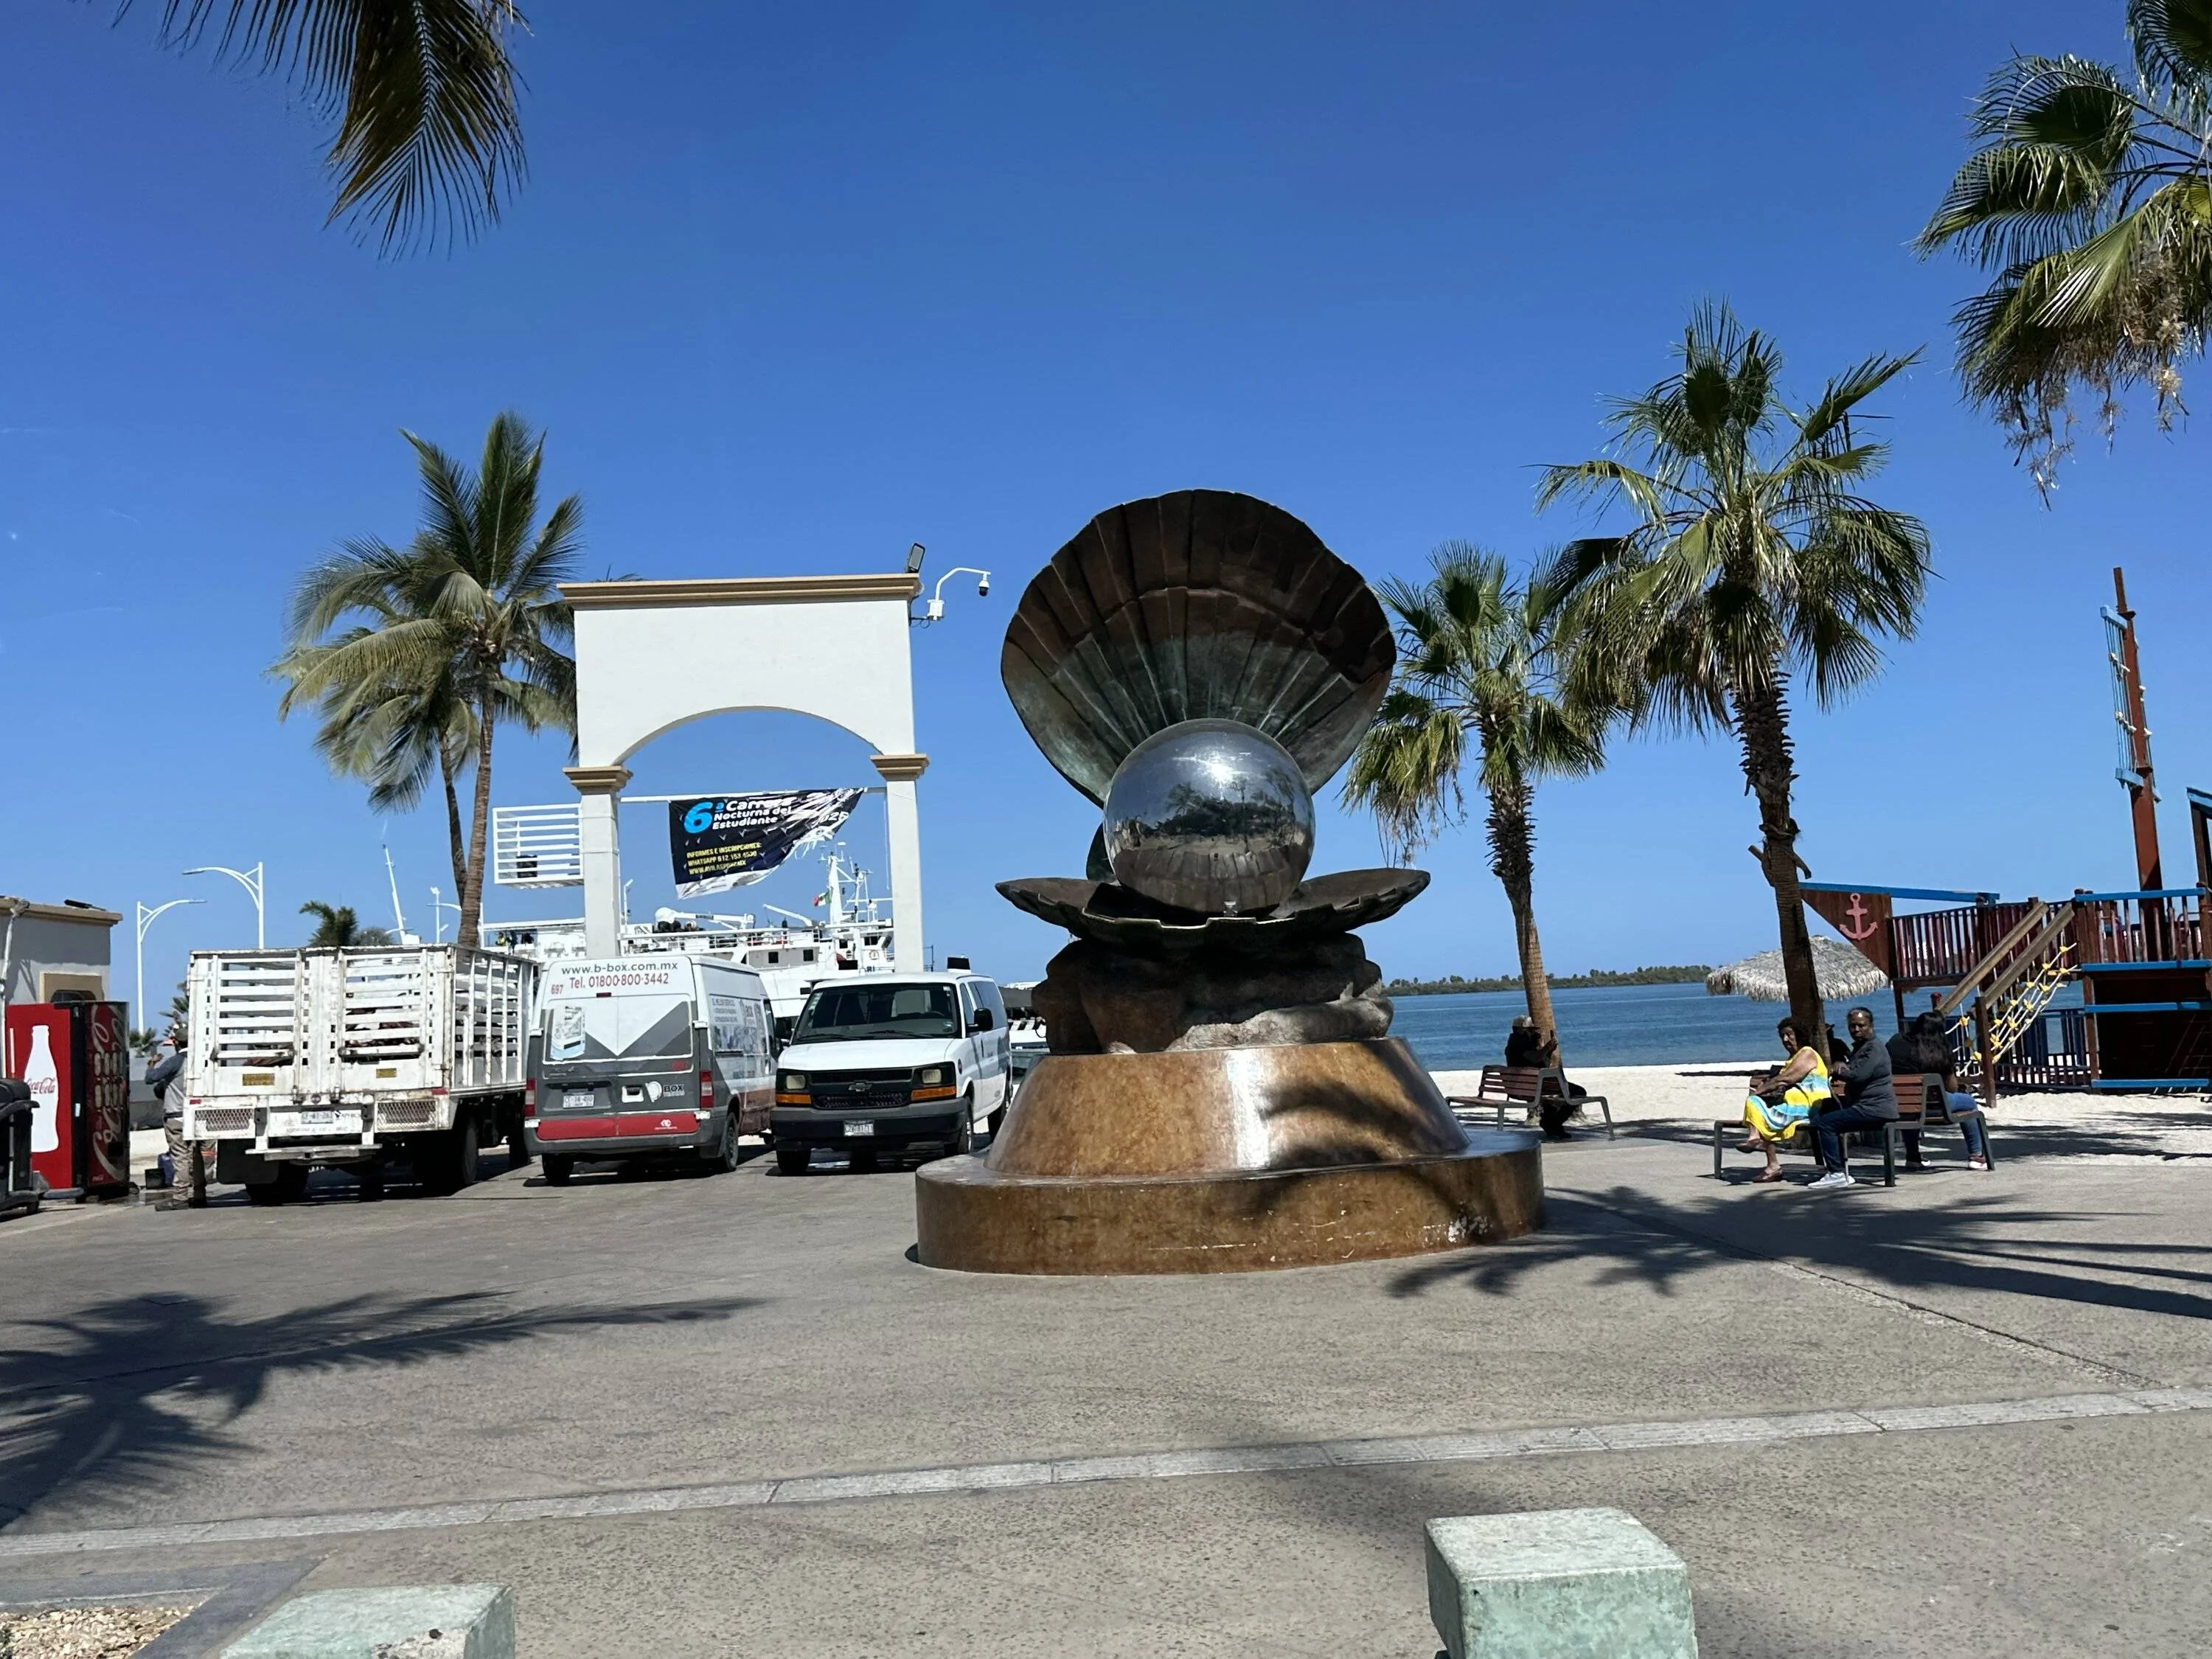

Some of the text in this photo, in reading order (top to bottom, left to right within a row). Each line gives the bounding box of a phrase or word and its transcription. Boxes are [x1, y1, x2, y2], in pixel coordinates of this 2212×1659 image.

[714, 806, 792, 821] Nocturna del
[712, 816, 779, 830] Estudiante
[686, 849, 714, 859] INFORMES
[688, 857, 717, 867] WHATSAPP
[561, 962, 678, 975] www.b-box.com.mx
[569, 977, 585, 989] Tel.
[551, 984, 564, 995] 697
[664, 1084, 684, 1093] BOX
